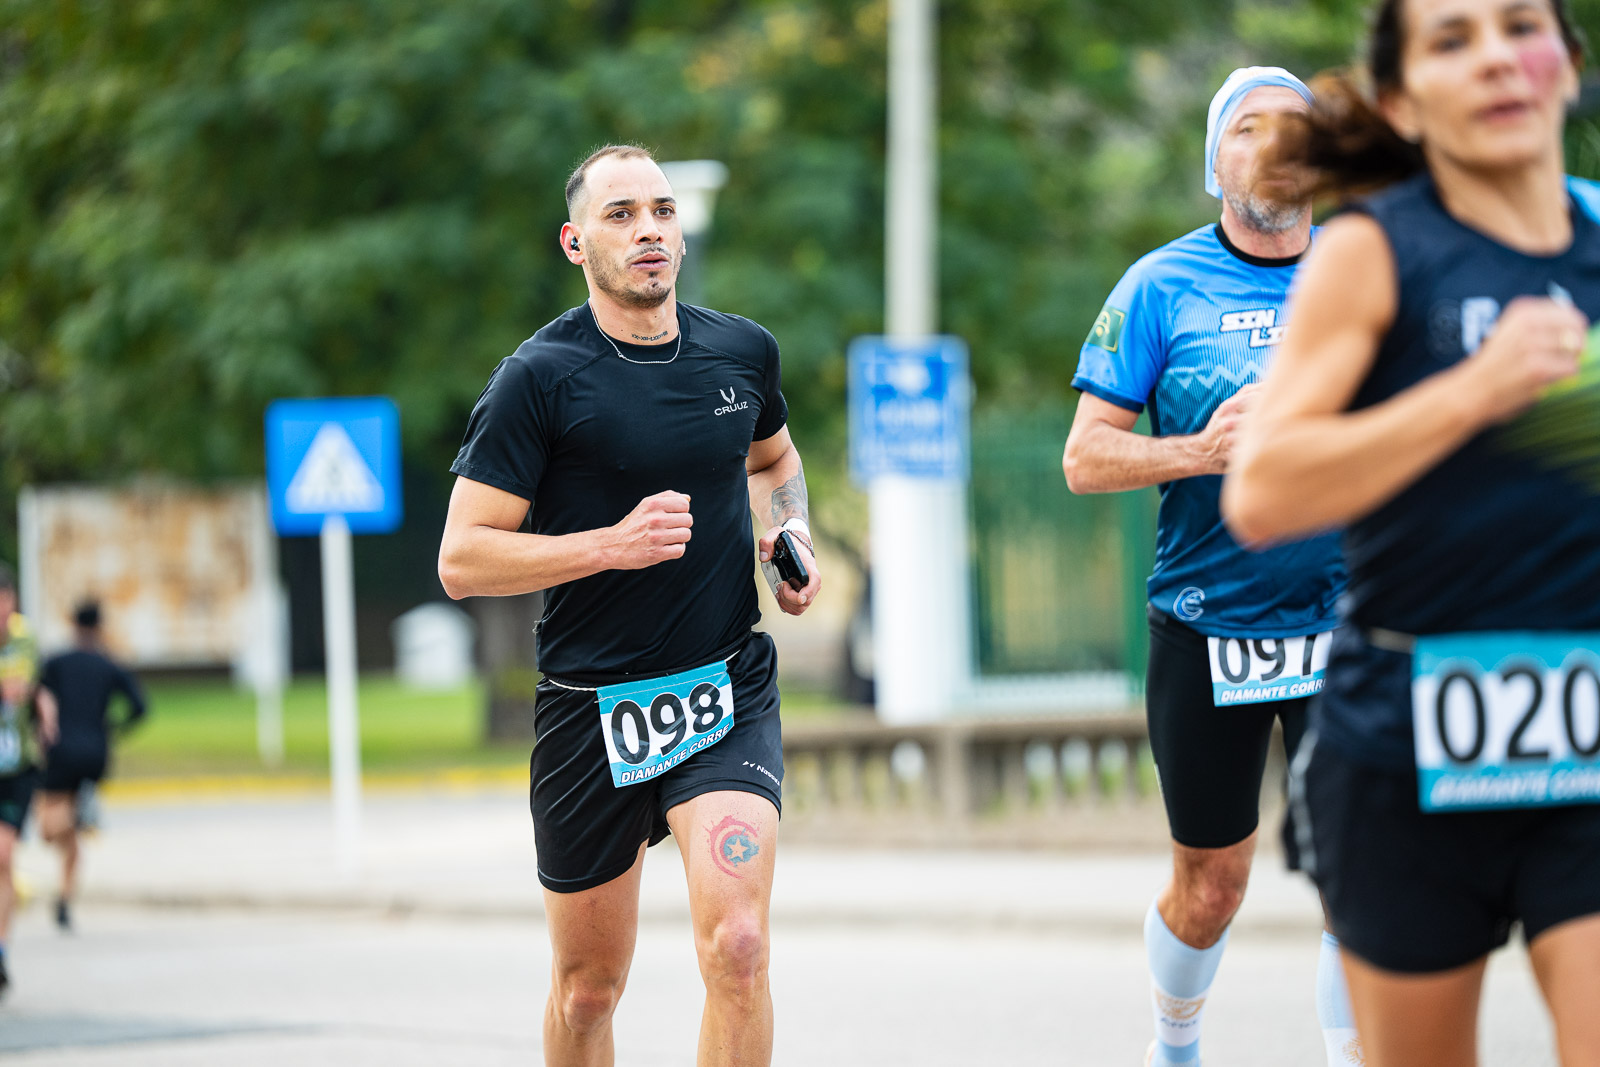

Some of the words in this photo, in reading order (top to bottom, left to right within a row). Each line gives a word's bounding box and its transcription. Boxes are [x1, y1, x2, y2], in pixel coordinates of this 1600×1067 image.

[1220, 308, 1276, 333] SIN
[1249, 326, 1287, 348] LI
[714, 401, 749, 416] CRUUZ
[1220, 685, 1288, 703] DIAMANTE
[1289, 679, 1326, 695] CORR
[611, 682, 724, 765] 098
[1437, 664, 1600, 763] 020
[620, 748, 688, 784] DIAMANTE
[688, 723, 731, 754] CORRE
